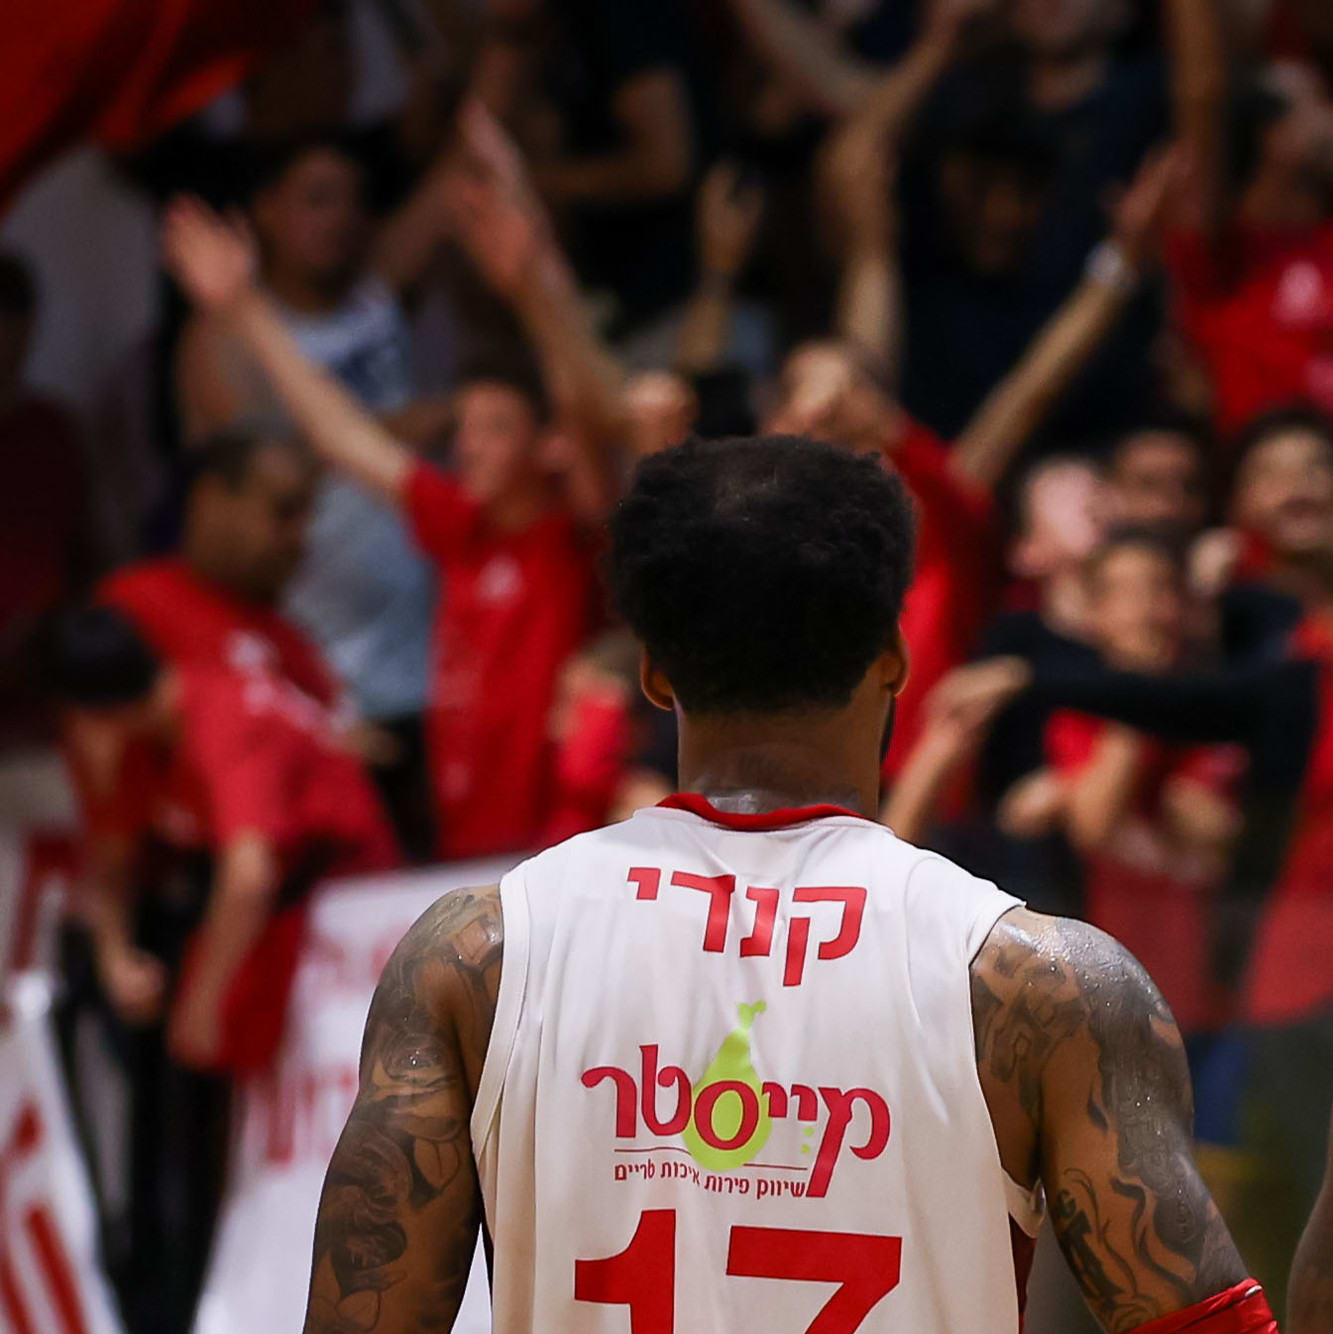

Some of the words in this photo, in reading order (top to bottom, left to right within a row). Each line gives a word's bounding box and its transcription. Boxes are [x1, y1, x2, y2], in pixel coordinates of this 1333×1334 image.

[627, 866, 868, 988] קנדי
[580, 1044, 891, 1198] מייסטר
[614, 1158, 656, 1181] טריים
[660, 1161, 700, 1186] איכות
[704, 1174, 750, 1194] פירות
[757, 1179, 806, 1200] שיווק
